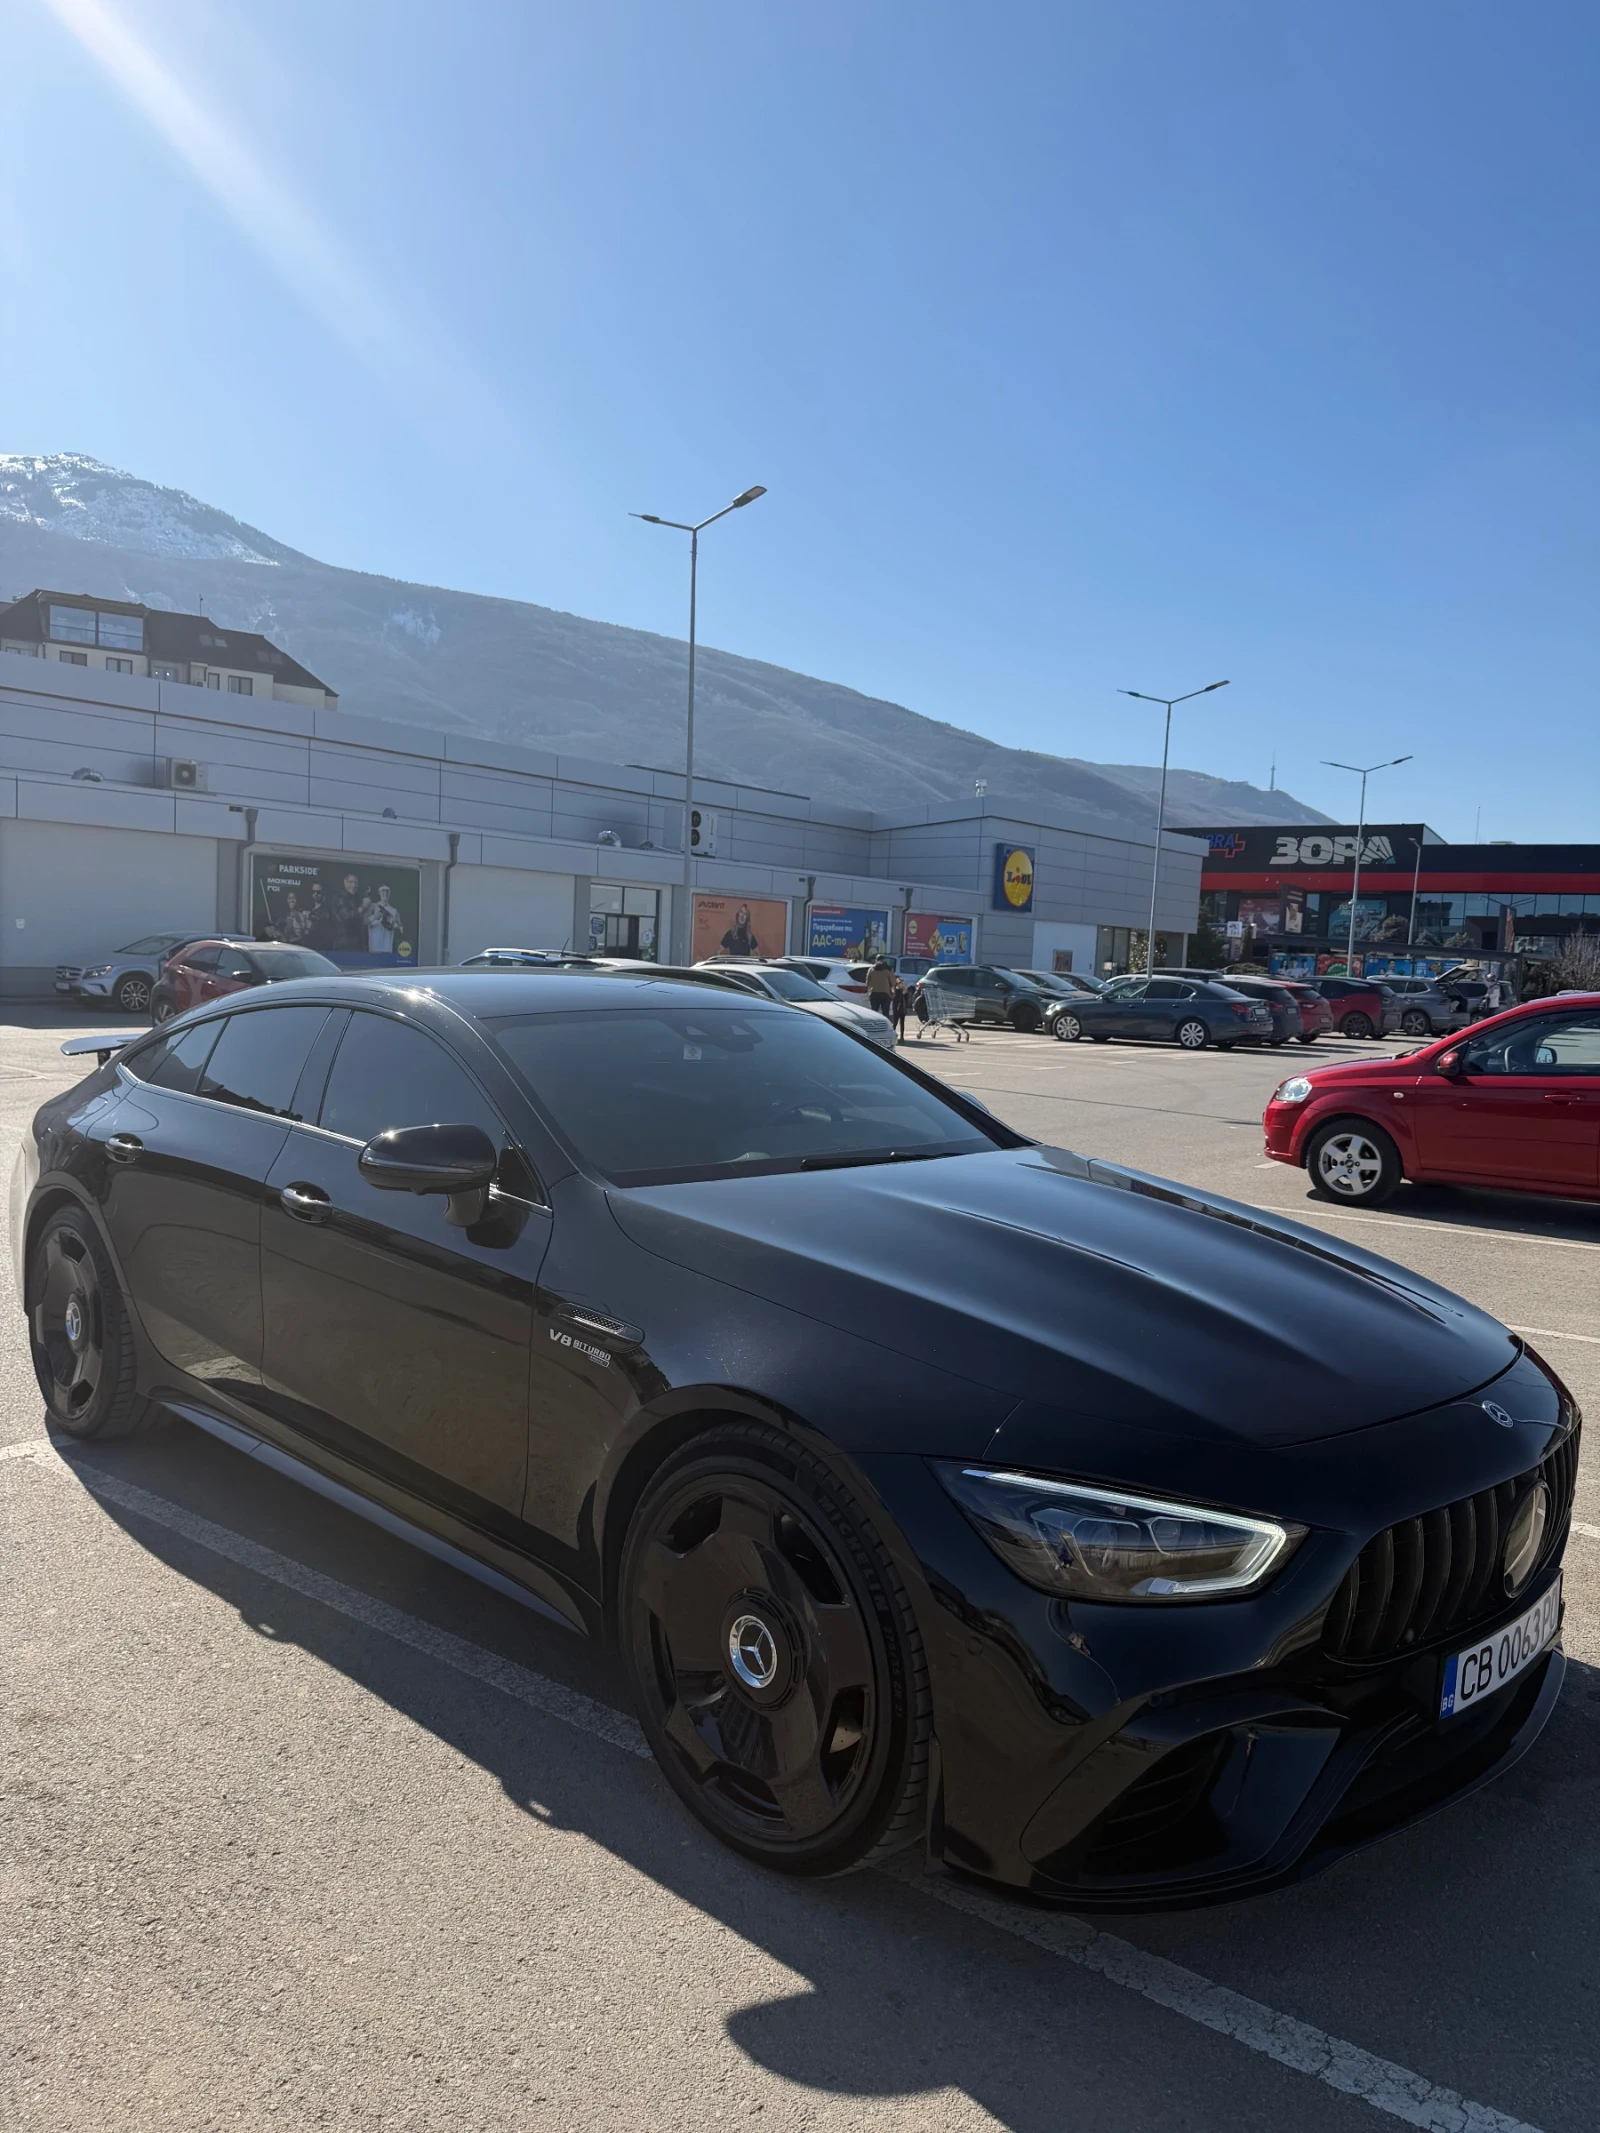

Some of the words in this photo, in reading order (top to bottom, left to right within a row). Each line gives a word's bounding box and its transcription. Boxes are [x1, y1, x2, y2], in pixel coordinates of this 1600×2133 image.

[1202, 833, 1235, 849] BRA
[1269, 836, 1396, 865] ЗОРА
[279, 864, 318, 876] PARKSIDE
[549, 1328, 573, 1347] V8
[573, 1339, 612, 1361] BITURBO
[818, 1495, 889, 1611] MICHELIN
[1460, 1644, 1493, 1701] CB
[1498, 1608, 1541, 1679] 0063
[1441, 1694, 1454, 1712] BG
